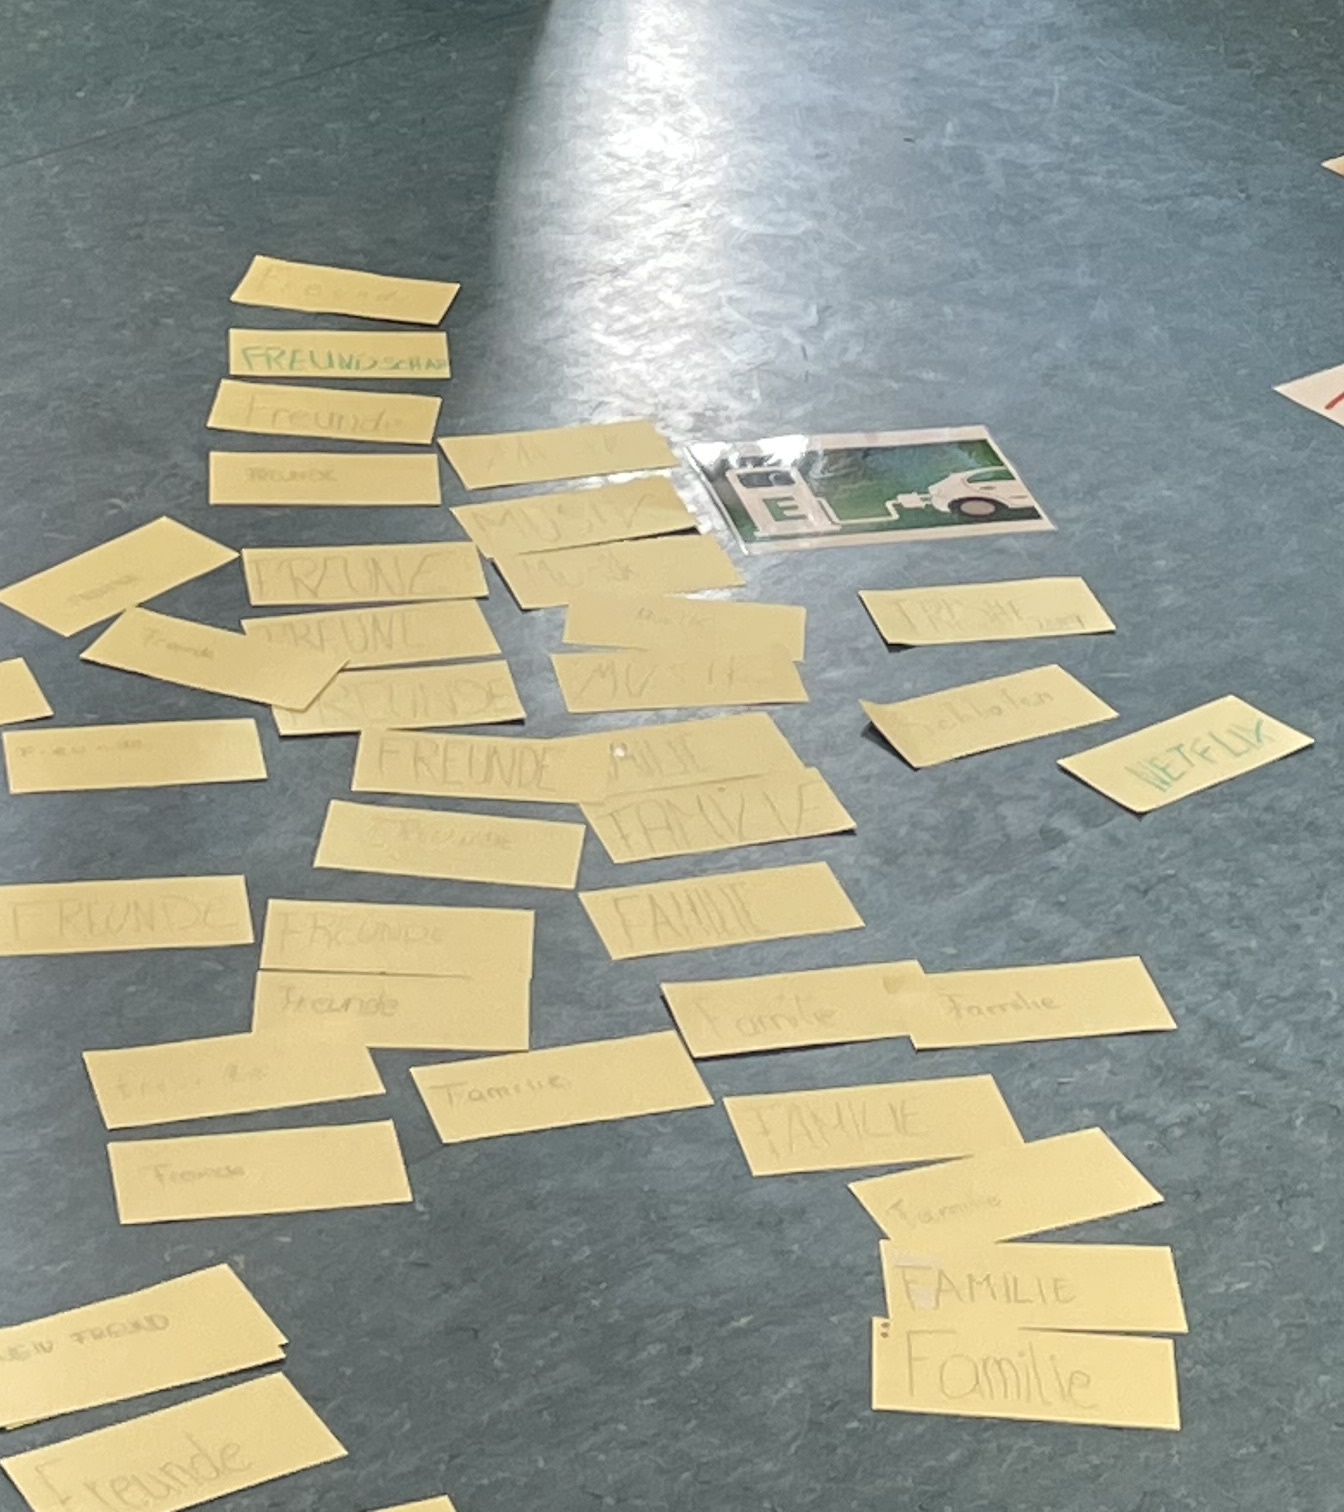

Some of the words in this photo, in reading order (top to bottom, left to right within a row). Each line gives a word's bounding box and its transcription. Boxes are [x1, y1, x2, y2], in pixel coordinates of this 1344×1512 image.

[762, 496, 807, 522] E
[377, 737, 568, 792] FREUNDE
[1123, 717, 1277, 794] NETFLIX
[8, 896, 240, 942] FREUNDE
[892, 1264, 1077, 1311] FAMILIE
[906, 1328, 1100, 1411] Familie
